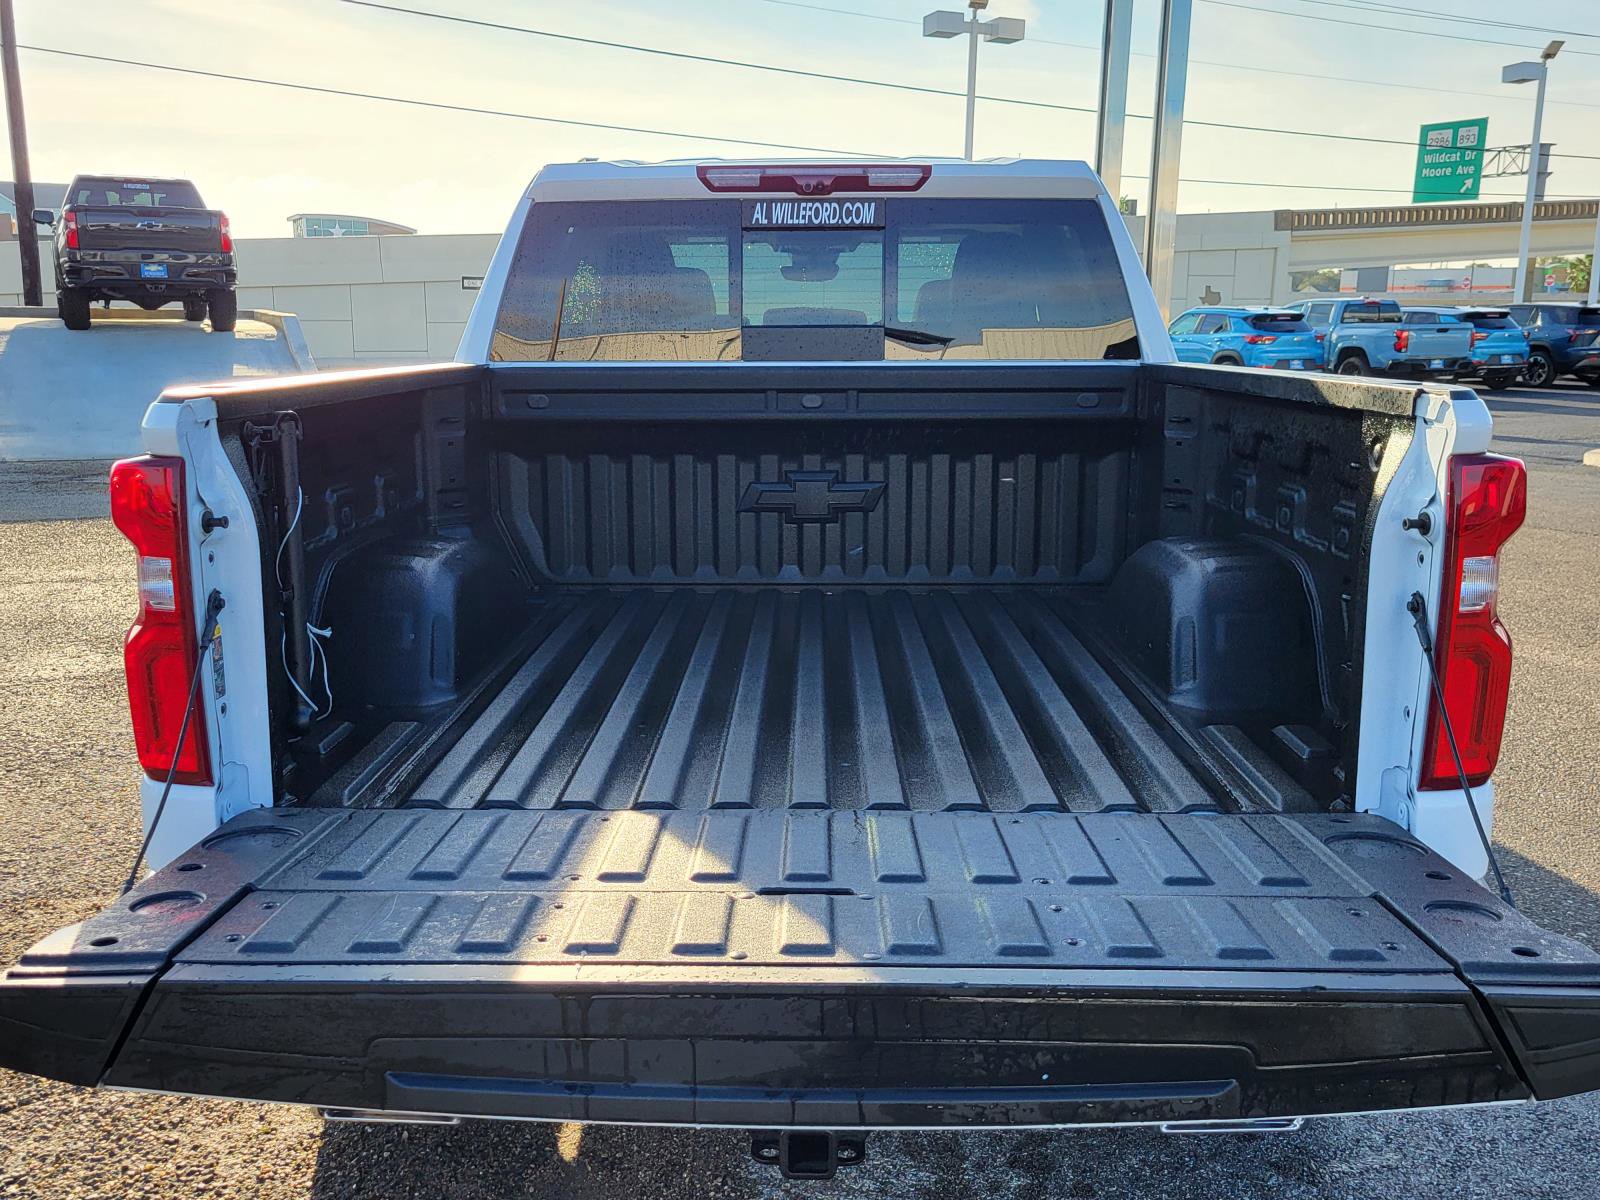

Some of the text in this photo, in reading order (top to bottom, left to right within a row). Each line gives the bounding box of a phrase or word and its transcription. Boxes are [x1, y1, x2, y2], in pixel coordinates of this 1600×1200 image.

[1459, 134, 1476, 145] 893
[1424, 151, 1477, 163] Wildcat Dr
[1422, 165, 1475, 177] Moore Ave
[752, 202, 875, 224] AL WILLEFORD.COM
